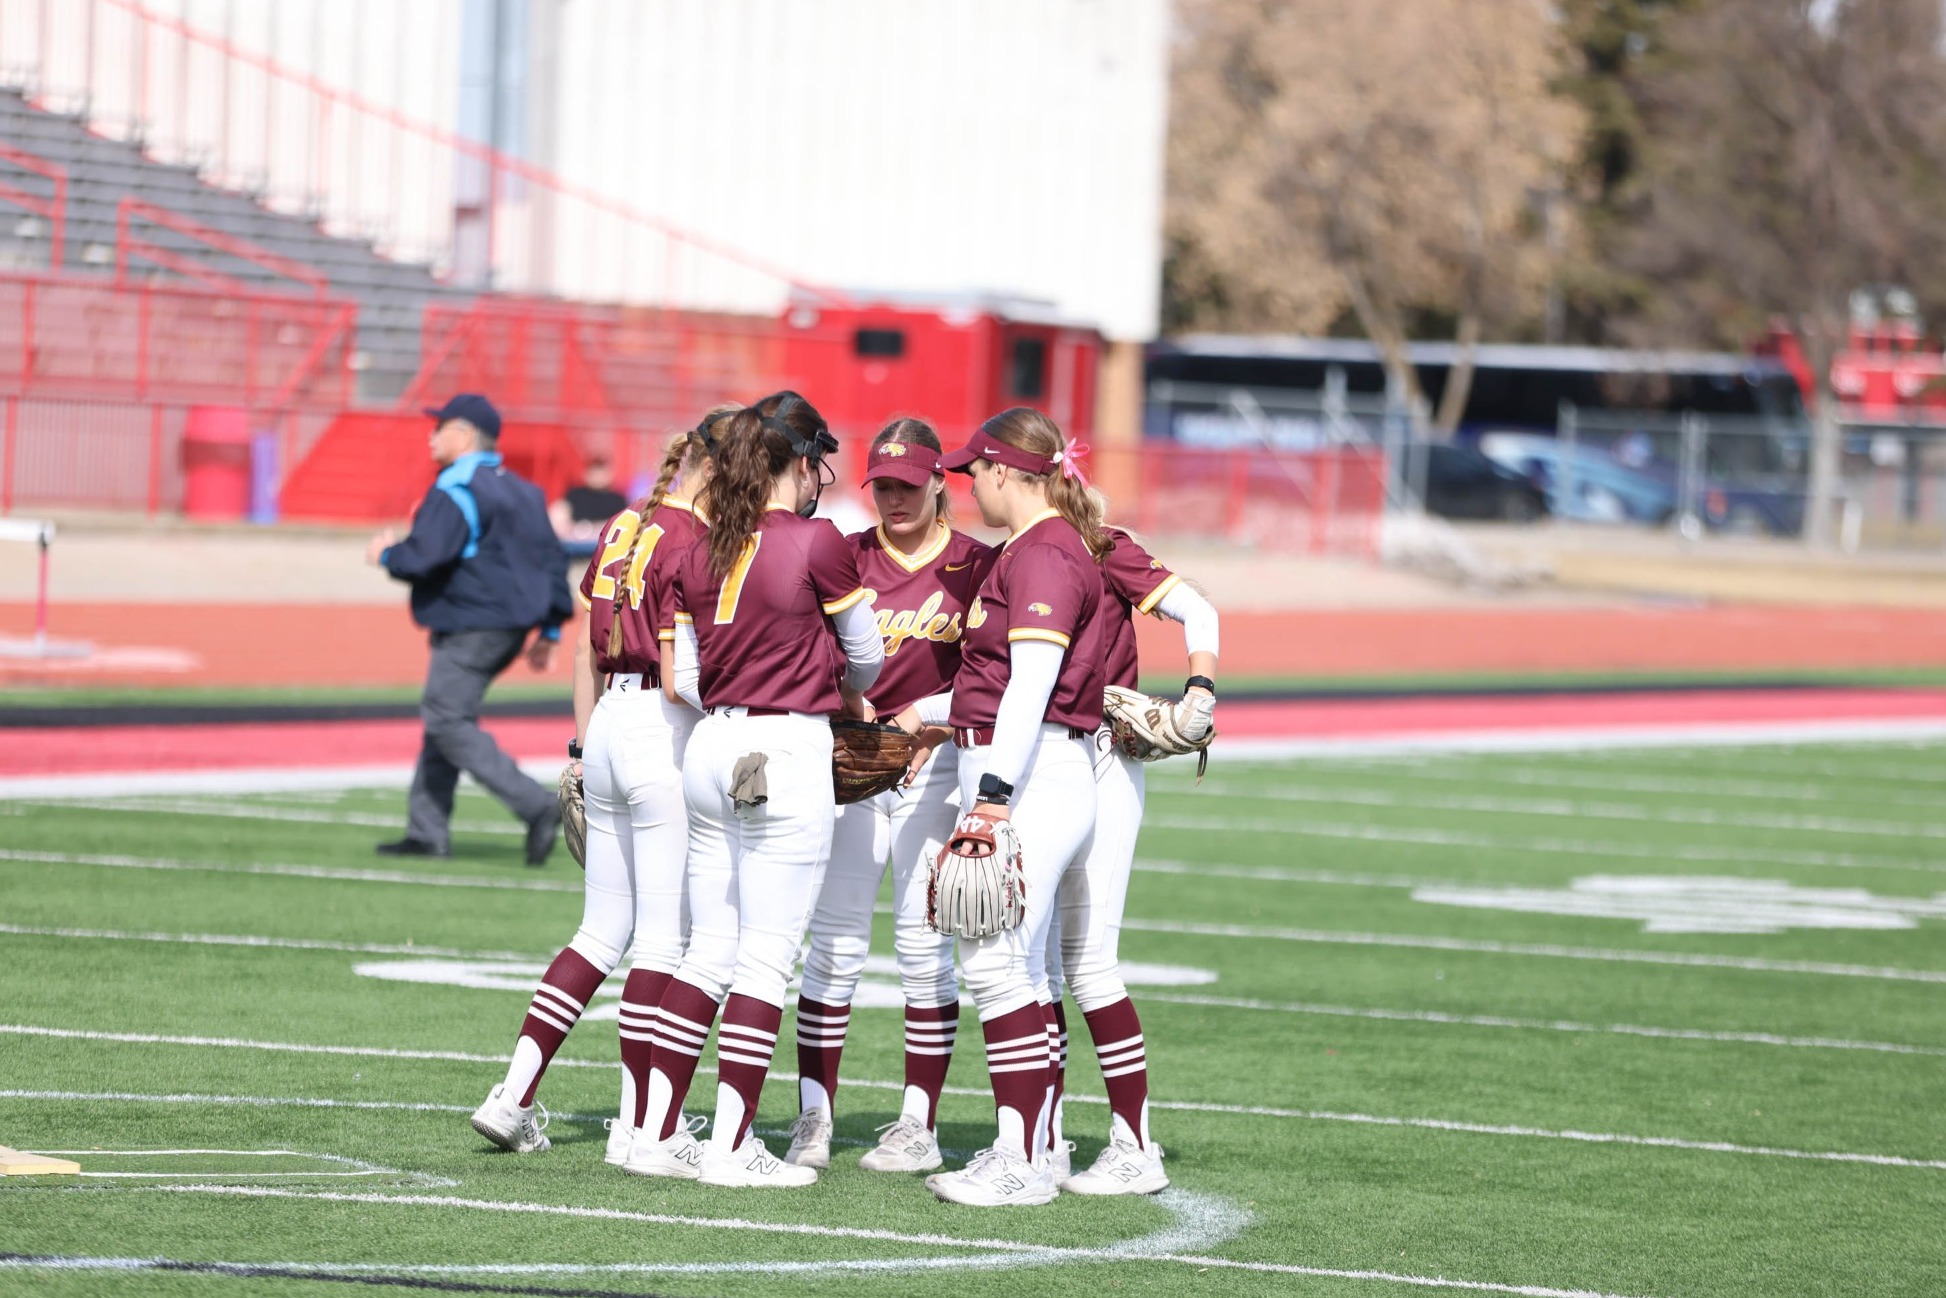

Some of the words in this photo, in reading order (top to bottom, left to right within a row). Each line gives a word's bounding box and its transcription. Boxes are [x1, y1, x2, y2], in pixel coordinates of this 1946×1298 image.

[591, 508, 666, 611] 24
[861, 588, 963, 657] agles
[745, 1154, 779, 1176] N
[1109, 1161, 1142, 1183] N
[990, 1172, 1025, 1195] N
